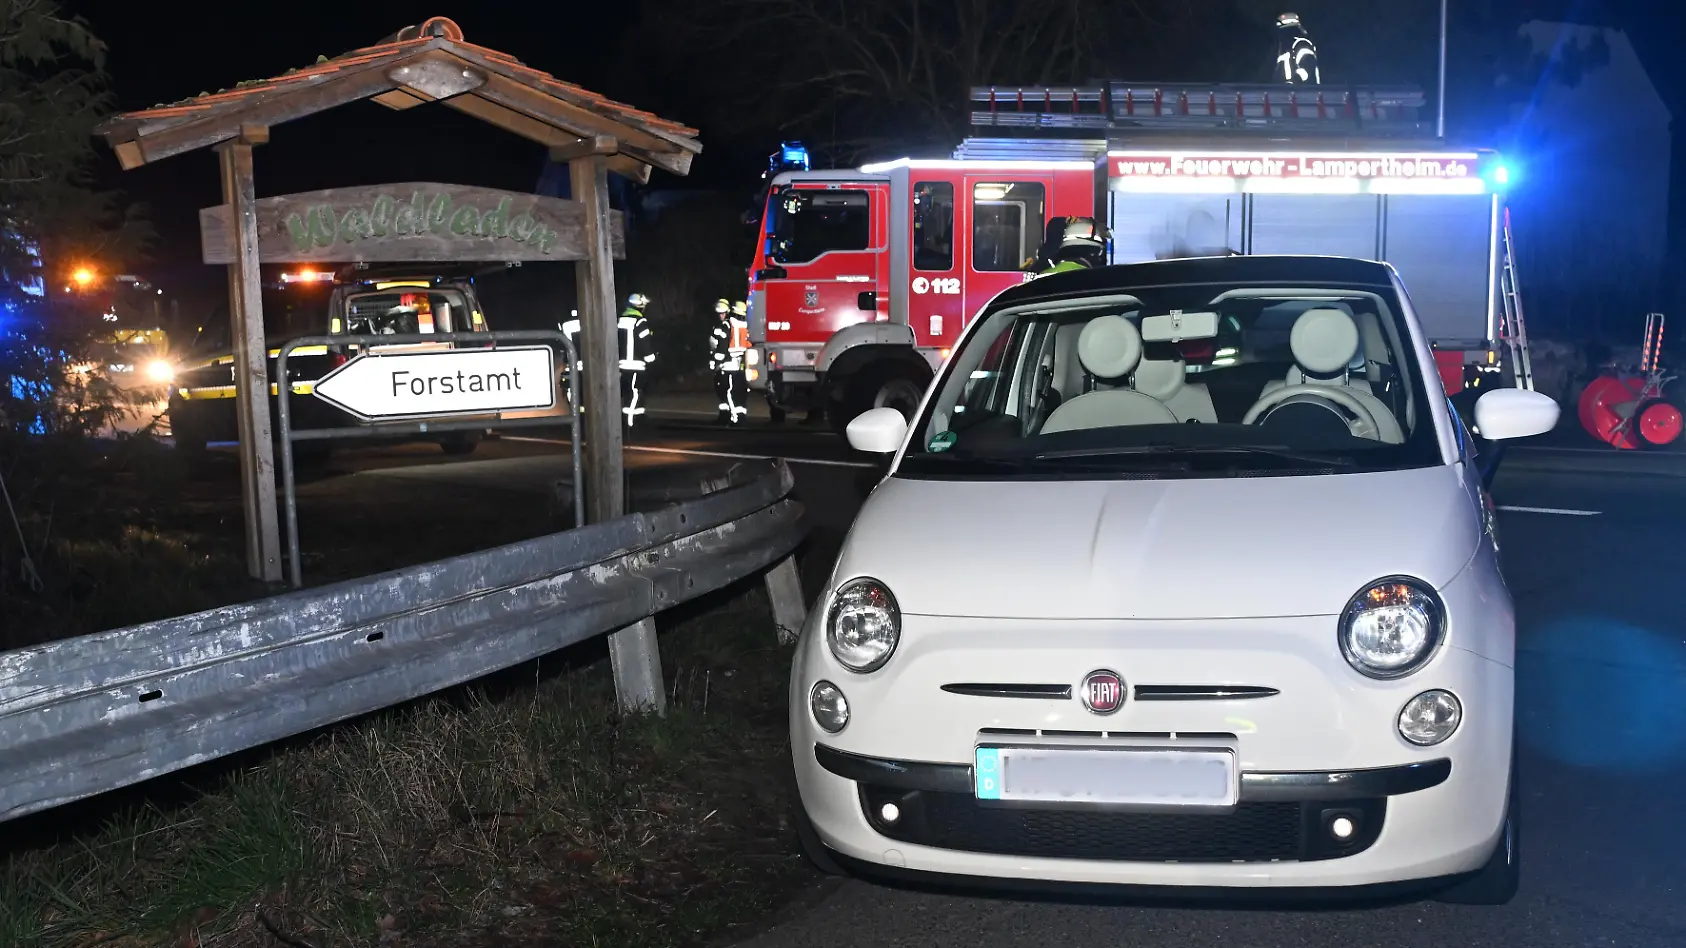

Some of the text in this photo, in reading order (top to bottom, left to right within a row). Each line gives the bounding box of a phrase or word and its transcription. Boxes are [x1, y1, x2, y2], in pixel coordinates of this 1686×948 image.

[286, 190, 558, 254] Waldladen
[931, 278, 960, 294] 112
[392, 367, 521, 397] Forstamt
[1090, 682, 1116, 703] FIAT
[984, 778, 994, 791] D
